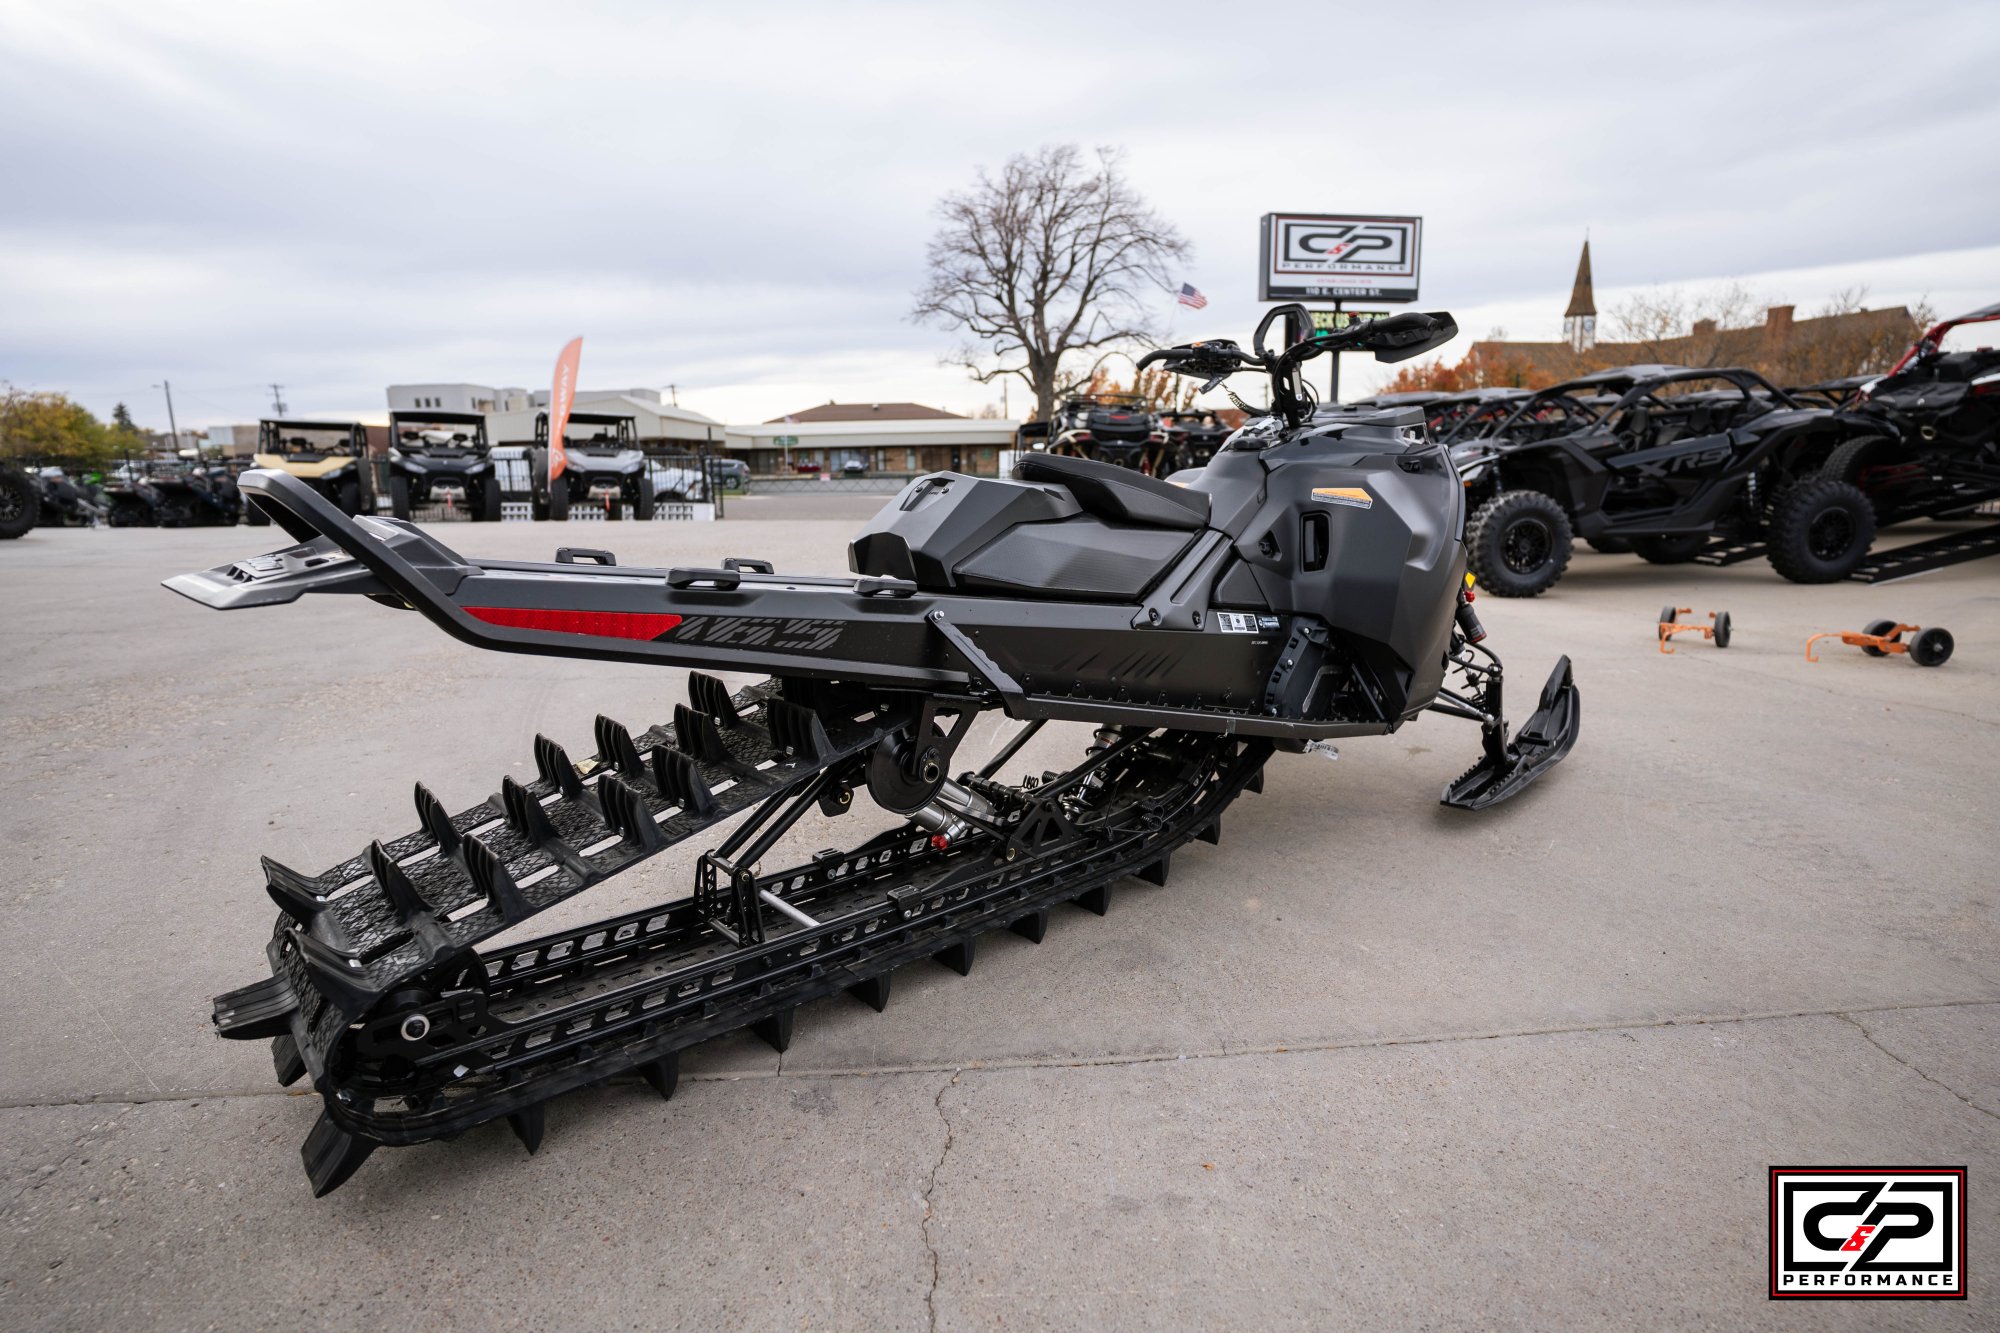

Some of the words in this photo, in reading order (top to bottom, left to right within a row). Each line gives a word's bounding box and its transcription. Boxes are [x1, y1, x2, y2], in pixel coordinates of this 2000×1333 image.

[1282, 262, 1405, 271] PERFORMANCE
[1305, 286, 1320, 295] 110
[1333, 287, 1367, 296] CENTER
